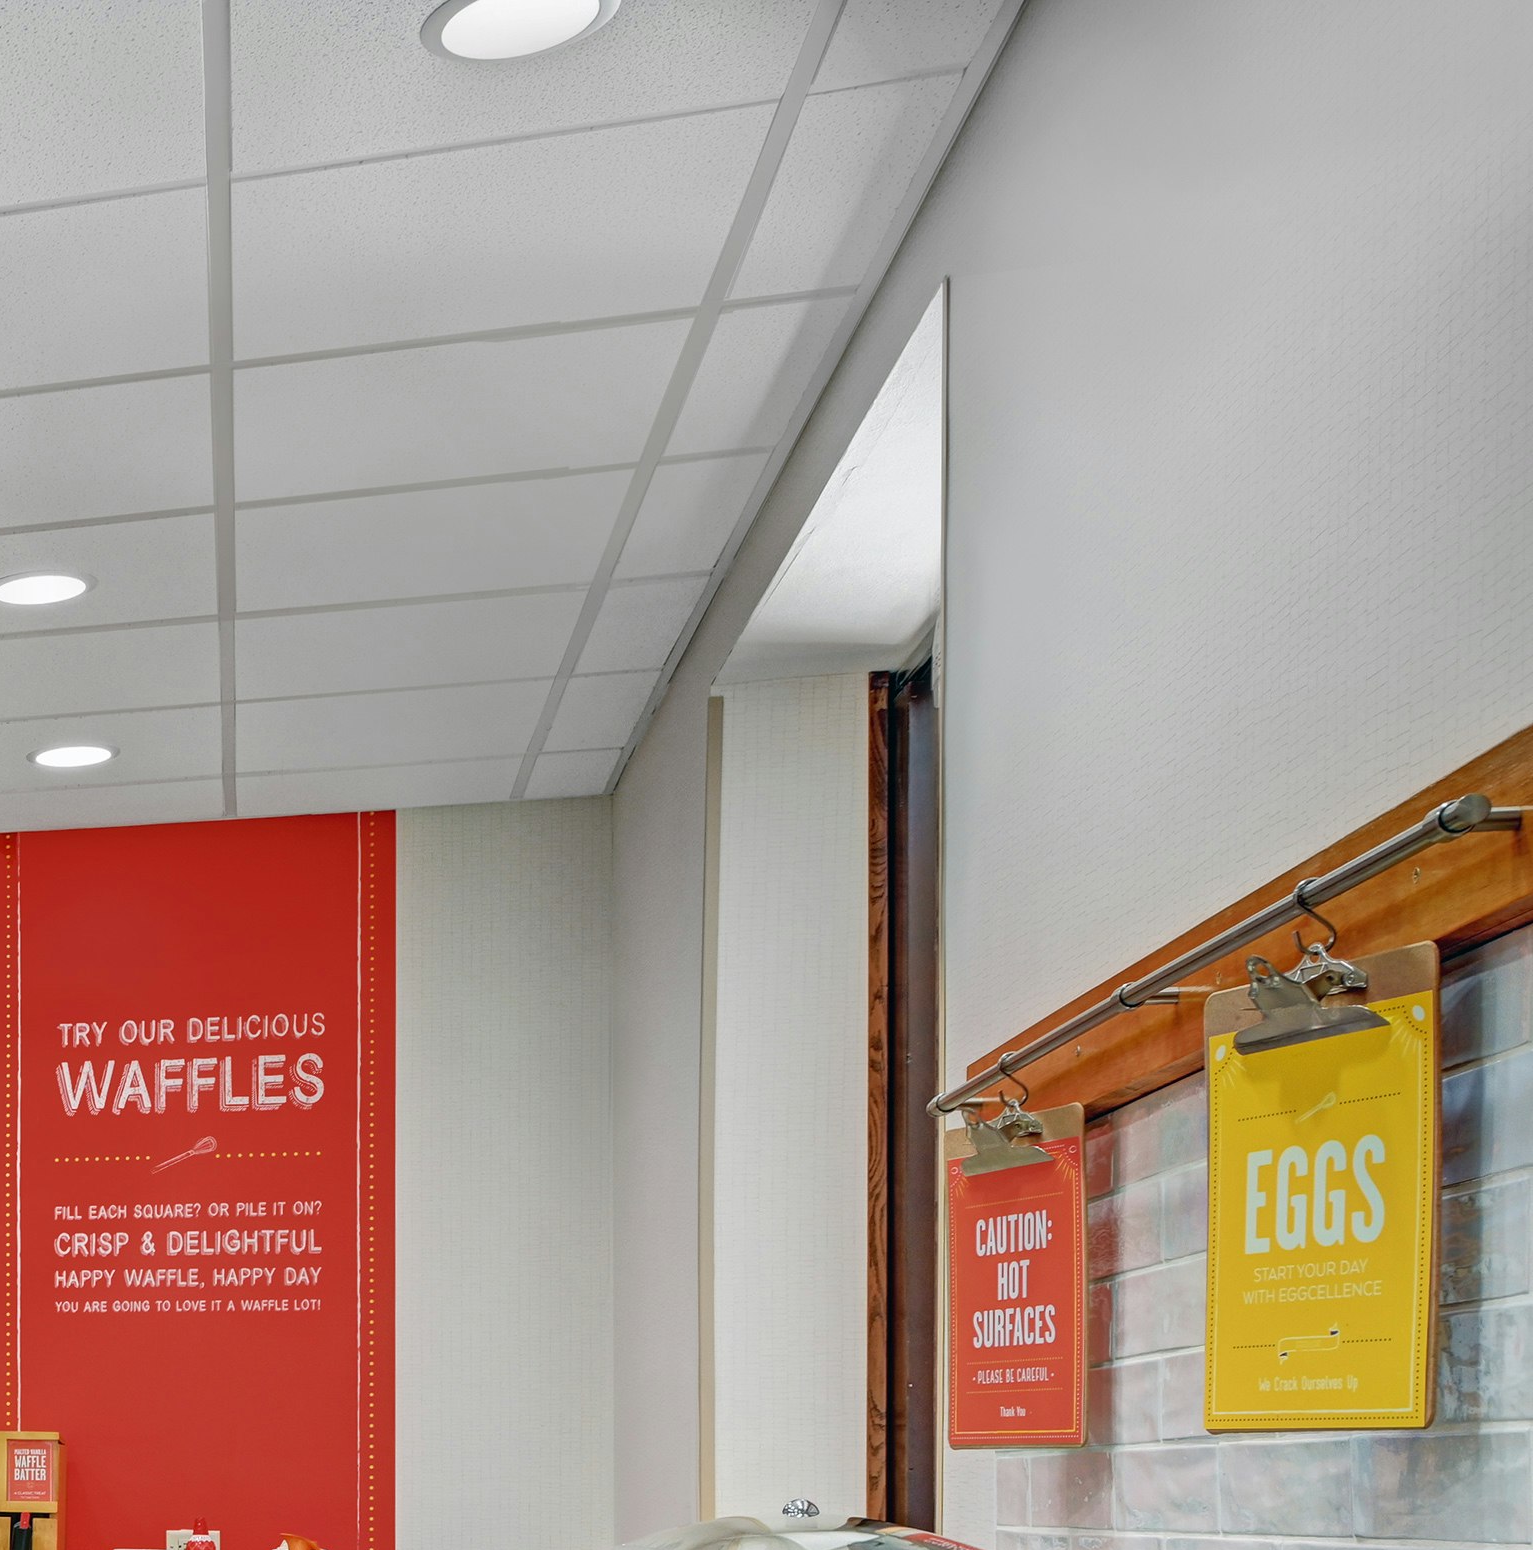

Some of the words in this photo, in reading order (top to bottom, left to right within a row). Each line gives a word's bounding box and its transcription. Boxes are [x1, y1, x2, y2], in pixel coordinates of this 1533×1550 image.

[57, 1021, 108, 1048] TRY
[118, 1019, 175, 1046] OUR
[187, 1012, 326, 1044] DELICIOUS
[55, 1052, 325, 1117] WAFFLES
[1244, 1133, 1386, 1255] EGGS
[54, 1206, 83, 1221] FILL
[88, 1204, 128, 1220] EACH
[134, 1203, 202, 1219] SQUARE?
[208, 1202, 230, 1218] OR
[236, 1202, 267, 1217] PILE
[273, 1201, 287, 1216] IT
[293, 1200, 323, 1216] ON?
[54, 1232, 129, 1258] CRISP
[140, 1231, 156, 1256] &
[166, 1228, 323, 1256] DELIGHTFUL
[975, 1209, 1053, 1257] CAUTION:
[54, 1269, 116, 1289] HAPPY
[123, 1268, 206, 1290] WAFFLE,
[212, 1267, 277, 1287] HAPPY
[284, 1266, 322, 1286] DAY
[997, 1259, 1030, 1301] HOT
[1253, 1265, 1295, 1283] START
[1296, 1261, 1336, 1279] YOUR
[1340, 1258, 1369, 1275] DAY
[1243, 1289, 1275, 1305] WITH
[1278, 1280, 1383, 1303] EGGCELLENCE
[54, 1301, 79, 1313] YOU
[83, 1300, 108, 1313] ARE
[112, 1300, 151, 1313] GOING
[155, 1300, 172, 1312] TO
[175, 1300, 207, 1312] LOVE
[210, 1299, 222, 1312] IT
[226, 1300, 236, 1312] A
[241, 1299, 289, 1312] WAFFLE
[293, 1299, 321, 1312] LOT!
[972, 1304, 1056, 1349] SURFACES
[977, 1369, 1004, 1385] PLEASE
[1006, 1368, 1015, 1383] BE
[1016, 1367, 1049, 1382] CAREFUL
[1258, 1377, 1270, 1392] We
[1274, 1376, 1298, 1391] Crack
[1301, 1375, 1343, 1390] Ourselves
[1346, 1374, 1358, 1393] Up
[999, 1406, 1015, 1417] Thank
[1016, 1406, 1026, 1417] You
[14, 1455, 47, 1468] WAFFLE
[14, 1468, 47, 1481] BATTER
